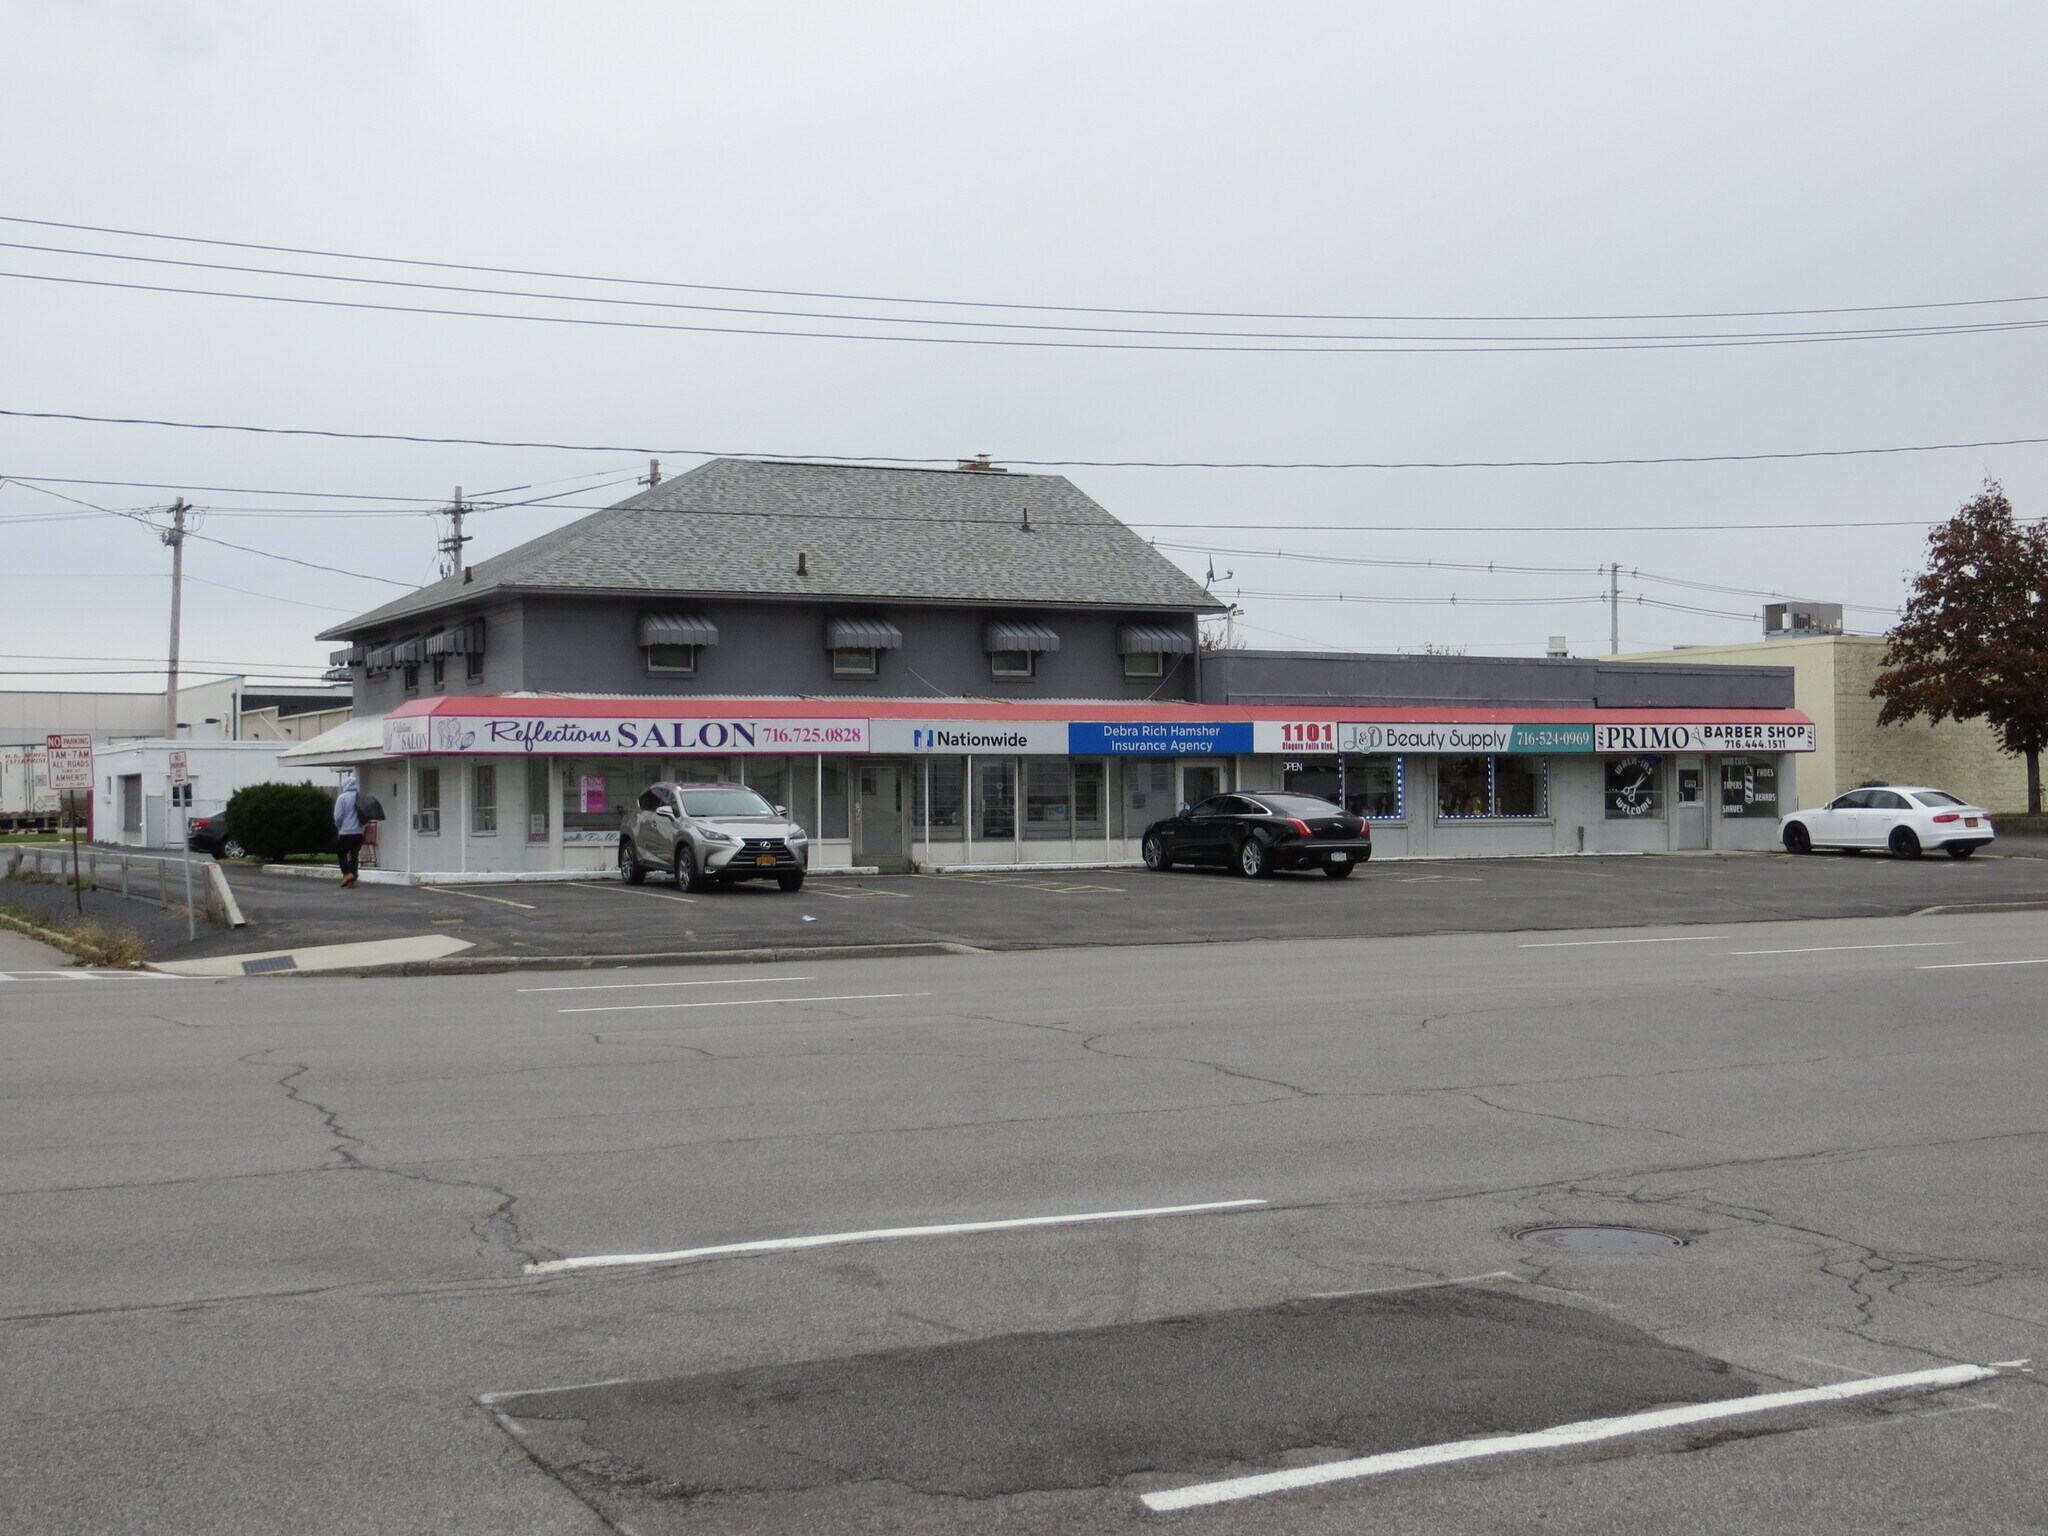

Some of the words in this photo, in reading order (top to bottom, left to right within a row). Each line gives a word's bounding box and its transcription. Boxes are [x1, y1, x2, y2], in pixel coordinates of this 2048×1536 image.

[484, 720, 611, 752] Reflections
[617, 722, 758, 748] SALON
[762, 728, 862, 743] 716.725.0828
[1103, 725, 1139, 737] Debra
[1142, 725, 1167, 737] Rich
[1169, 726, 1220, 737] Hamsher
[1281, 723, 1332, 742] 1101
[1704, 726, 1764, 738] BARBER
[1767, 726, 1806, 738] SHOP
[48, 736, 60, 748] NO
[63, 737, 89, 745] PARKING
[402, 732, 428, 750] SALON
[937, 731, 1028, 747] Nationwide
[1387, 729, 1445, 750] Beauty
[1450, 729, 1507, 750] Supply
[1606, 726, 1690, 749] PRIMO
[1111, 740, 1167, 751] Insurance
[1169, 740, 1213, 752] Agency
[1724, 740, 1786, 749] 716.444.1511
[67, 760, 90, 768] ROADS
[56, 774, 88, 782] AMHERST
[1757, 768, 1774, 777] FADES
[1723, 781, 1743, 789] TAPERS
[1755, 793, 1776, 801] BEARDS
[1615, 797, 1653, 816] WELCOME
[1722, 804, 1744, 813] SHAVES
